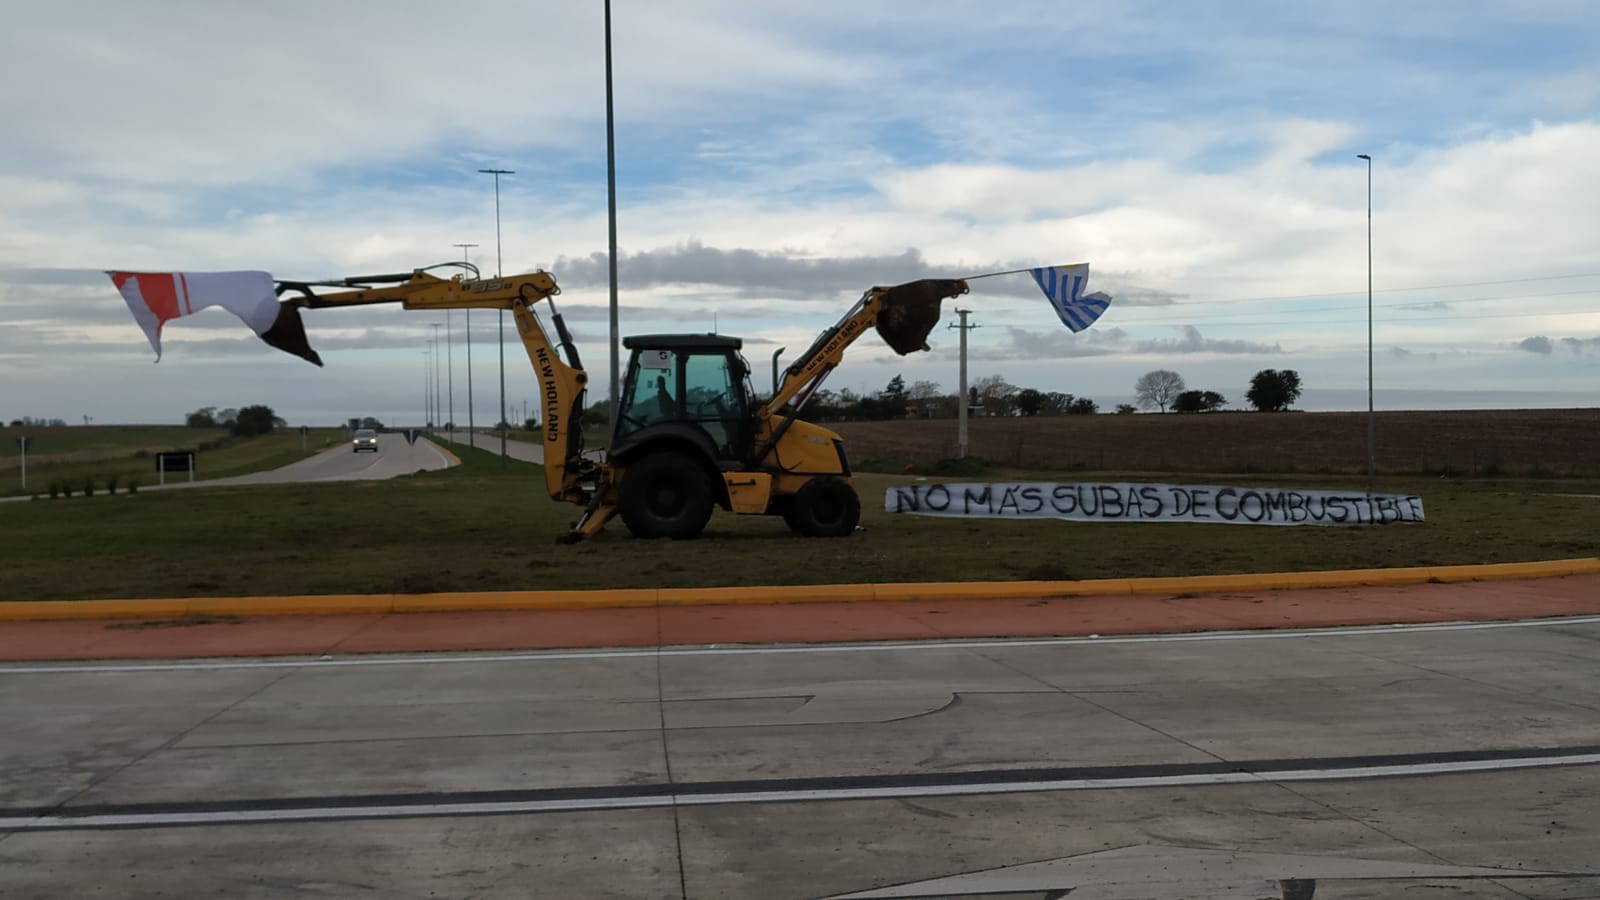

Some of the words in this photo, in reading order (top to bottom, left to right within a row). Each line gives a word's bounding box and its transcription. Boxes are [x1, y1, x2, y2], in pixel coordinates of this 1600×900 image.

[536, 347, 554, 378] NEW
[545, 381, 559, 442] HOLLAND
[895, 484, 951, 514] NO
[963, 485, 1045, 515] MÁS
[1051, 485, 1163, 518] SUBAS
[1168, 487, 1210, 518] DE
[1215, 488, 1425, 525] COMBUSTIBLE
